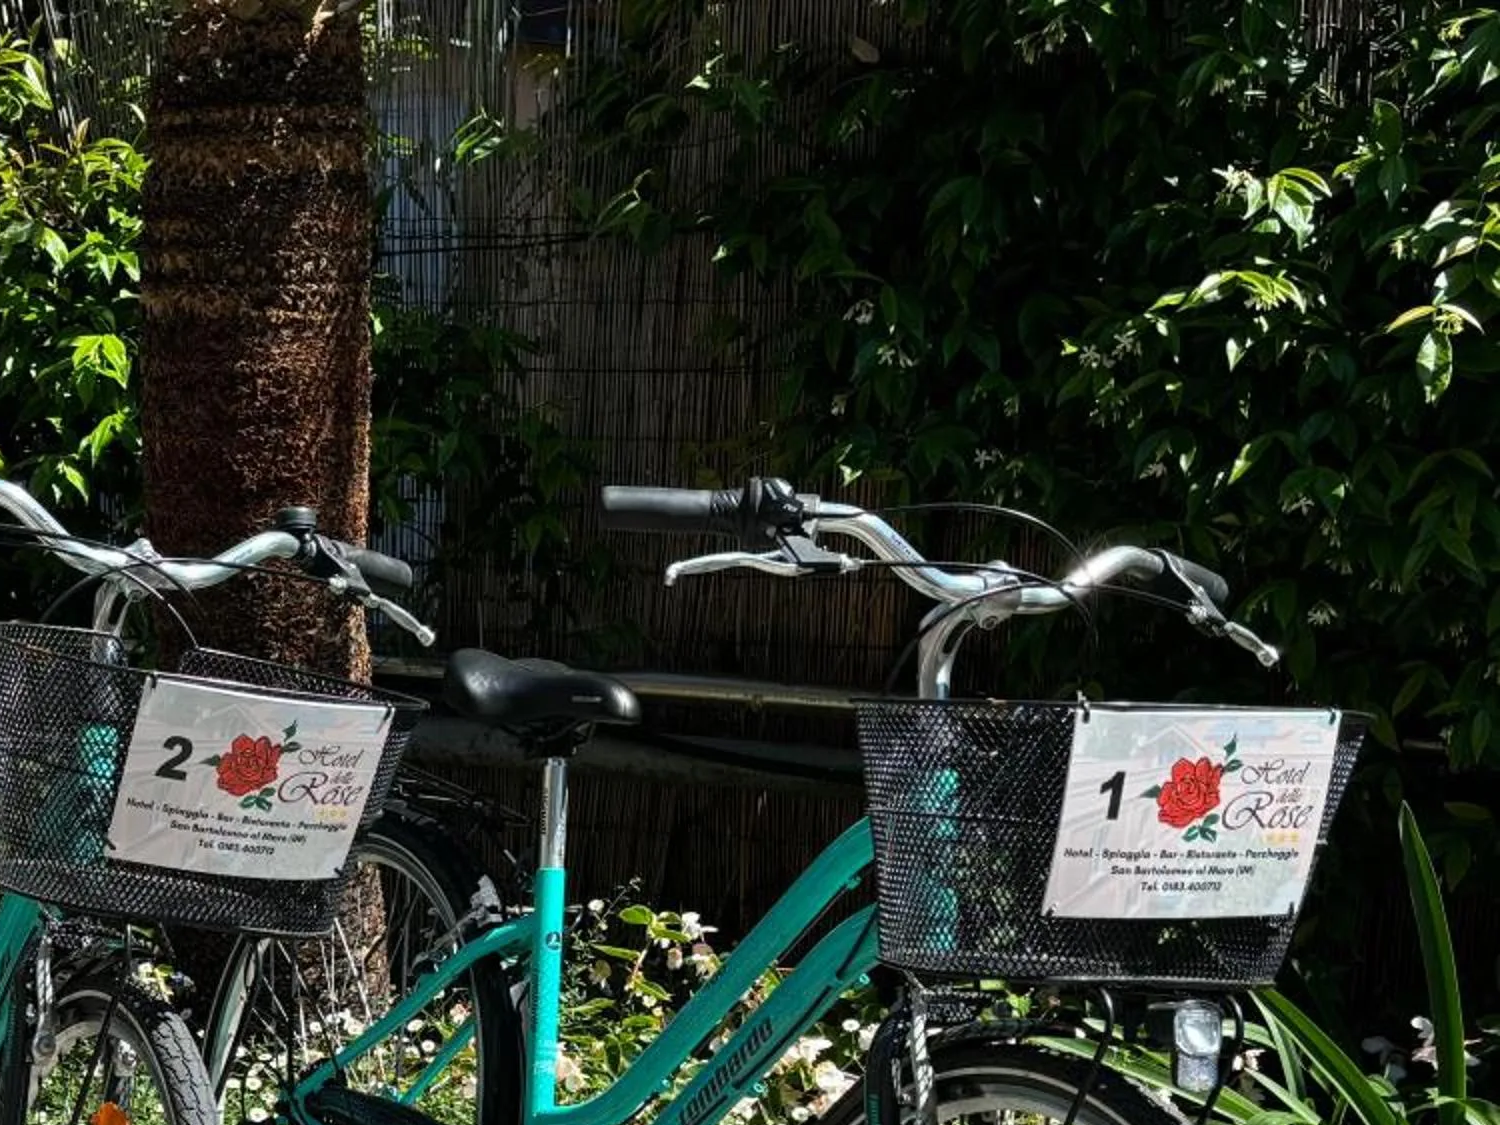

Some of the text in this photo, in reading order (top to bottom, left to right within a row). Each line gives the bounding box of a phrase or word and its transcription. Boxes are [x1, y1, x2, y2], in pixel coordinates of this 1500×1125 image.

[154, 736, 193, 781] 2
[298, 745, 364, 768] Hotel
[1240, 758, 1311, 784] Hotel
[126, 797, 154, 809] Hotel
[277, 771, 364, 806] Rose
[1099, 771, 1126, 820] 1
[1221, 790, 1314, 830] Rose
[1063, 848, 1093, 857] Hotel
